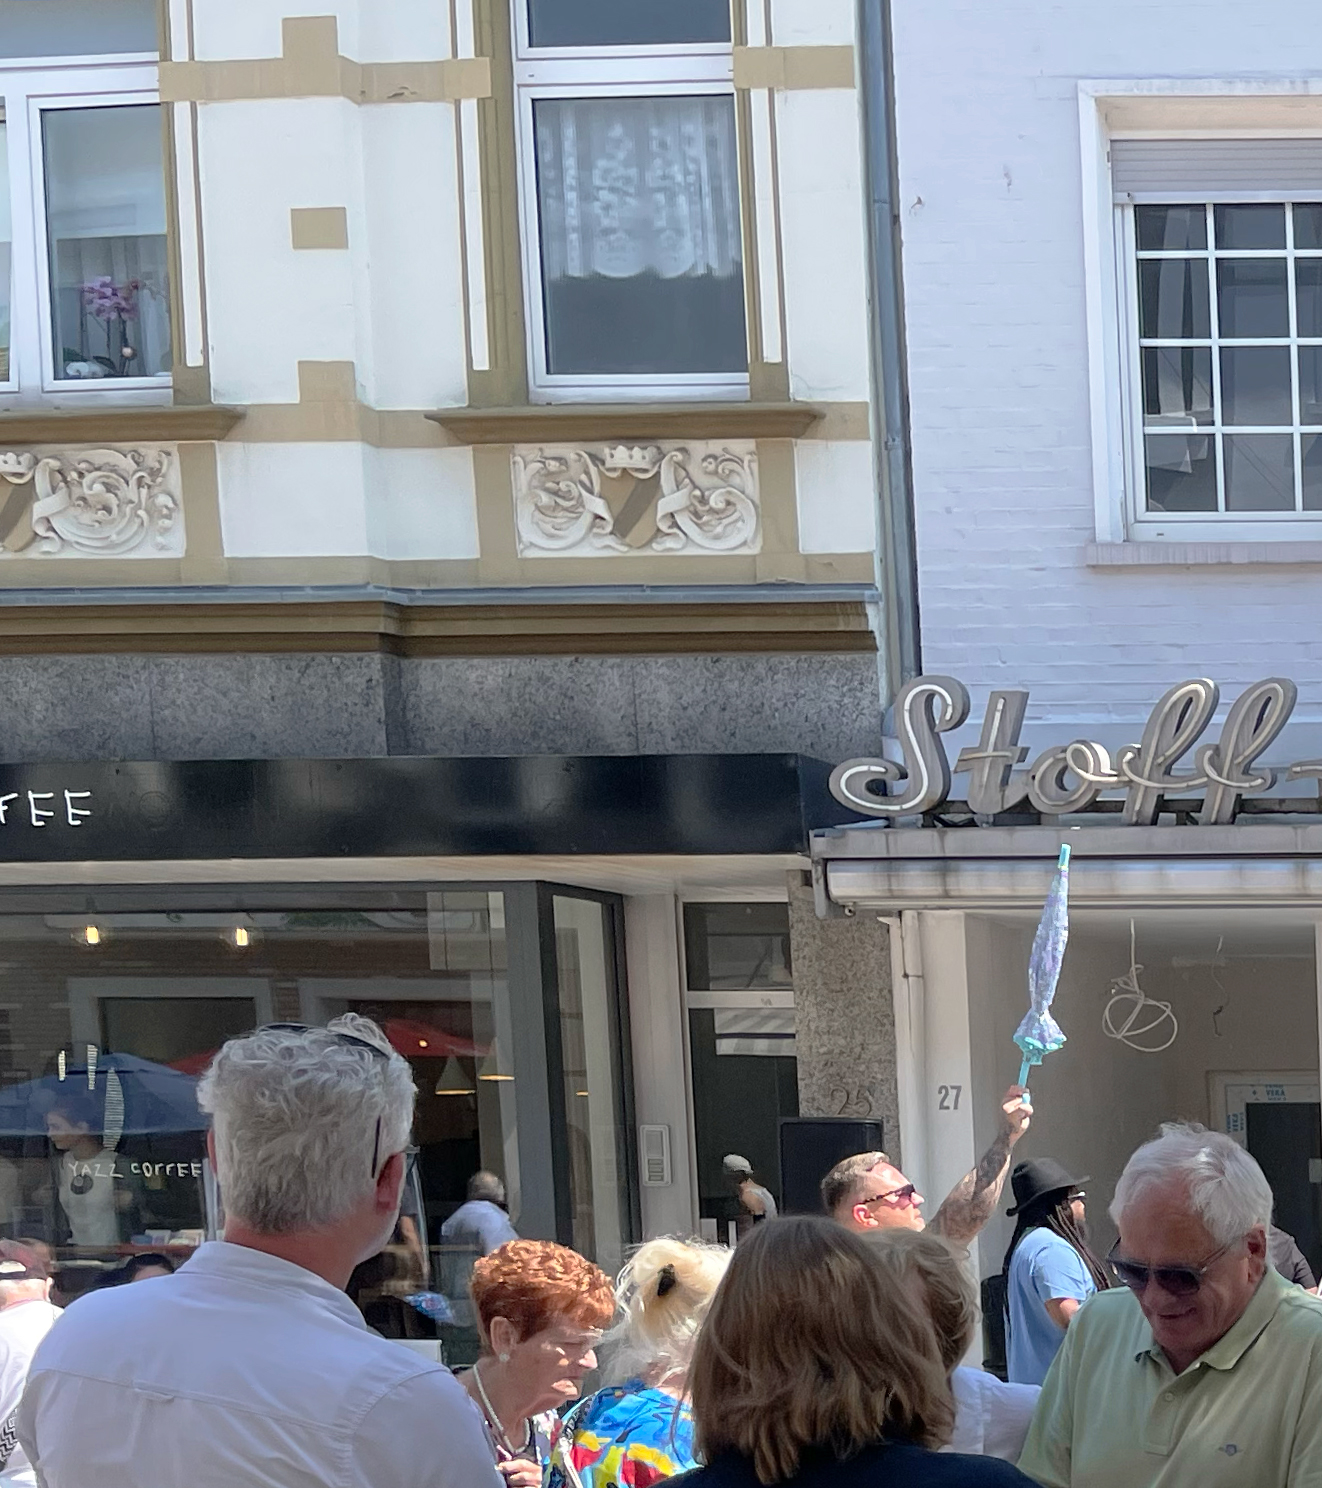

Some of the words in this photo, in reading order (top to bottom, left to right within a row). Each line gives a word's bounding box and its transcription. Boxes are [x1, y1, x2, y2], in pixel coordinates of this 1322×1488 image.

[830, 1086, 873, 1116] 25
[937, 1085, 962, 1111] 27
[68, 1162, 124, 1179] YAZZ
